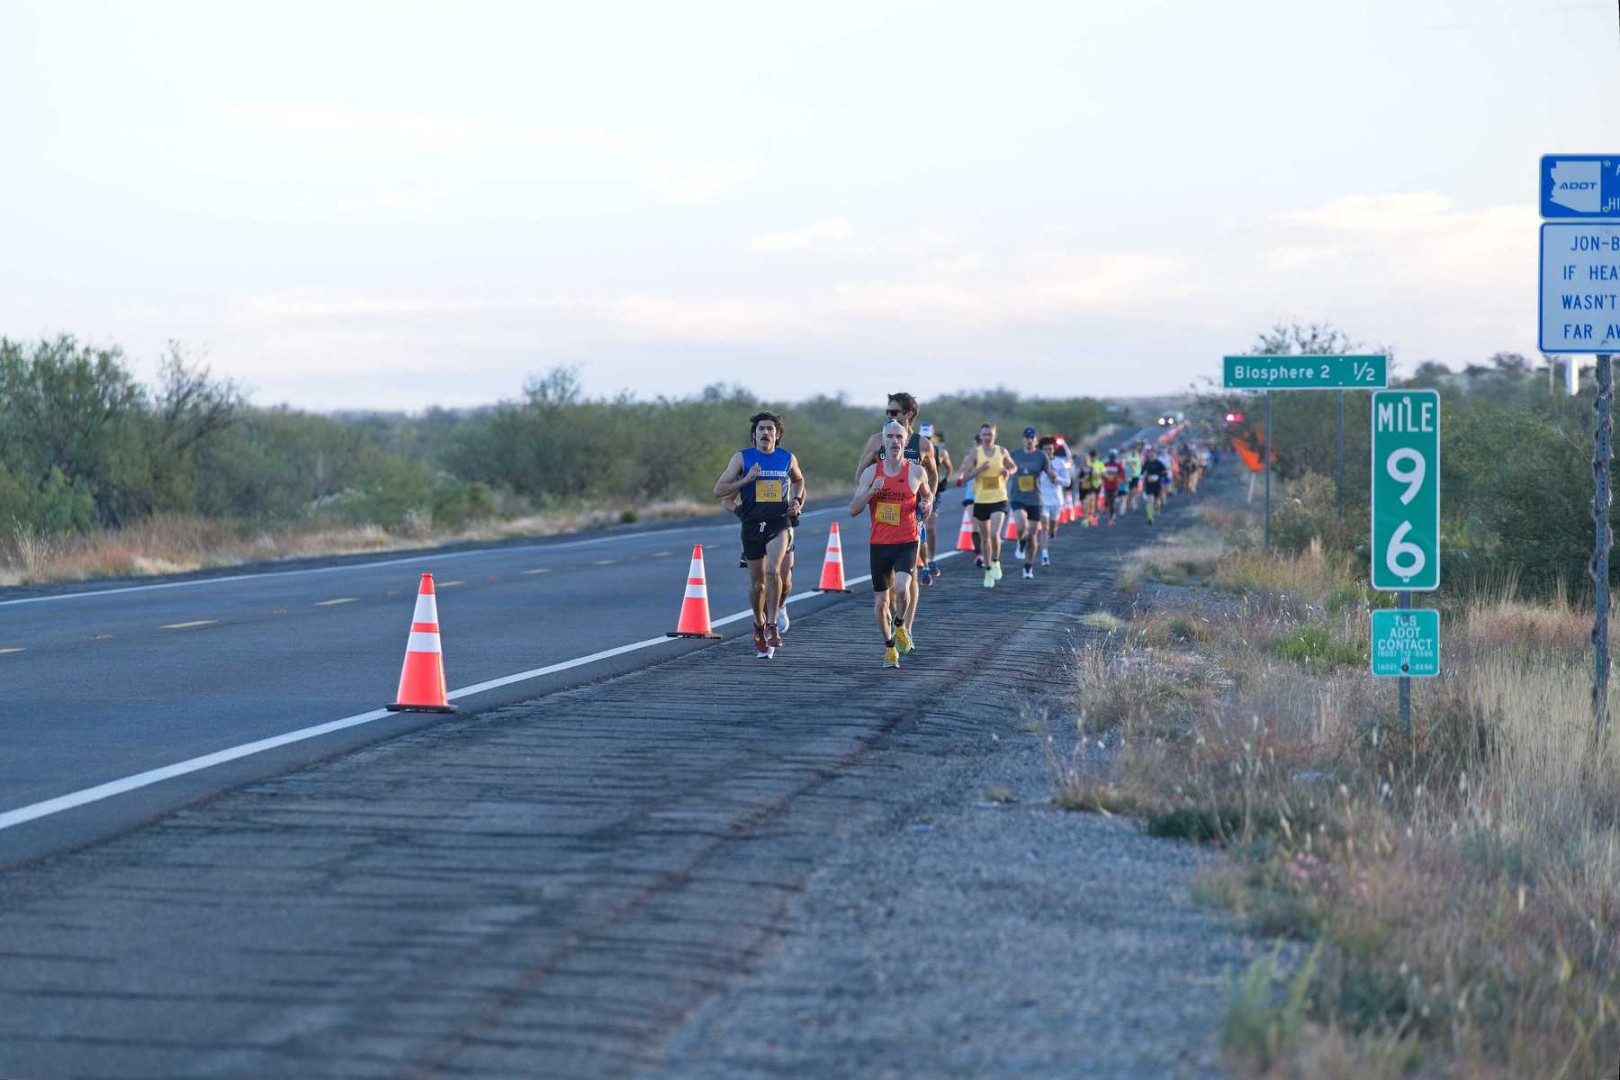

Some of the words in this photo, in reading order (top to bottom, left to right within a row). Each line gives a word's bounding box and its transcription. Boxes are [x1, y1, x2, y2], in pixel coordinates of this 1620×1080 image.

[1559, 182, 1598, 190] ADOT
[1563, 265, 1576, 280] IF
[1589, 265, 1620, 280] HEA
[1562, 294, 1617, 310] WASN'T
[1564, 324, 1592, 339] FAR
[1234, 365, 1314, 381] Biosphere
[1320, 365, 1330, 378] 2
[1378, 402, 1433, 432] MILE
[1390, 627, 1421, 638] ADOT
[1378, 638, 1432, 650] CONTACT
